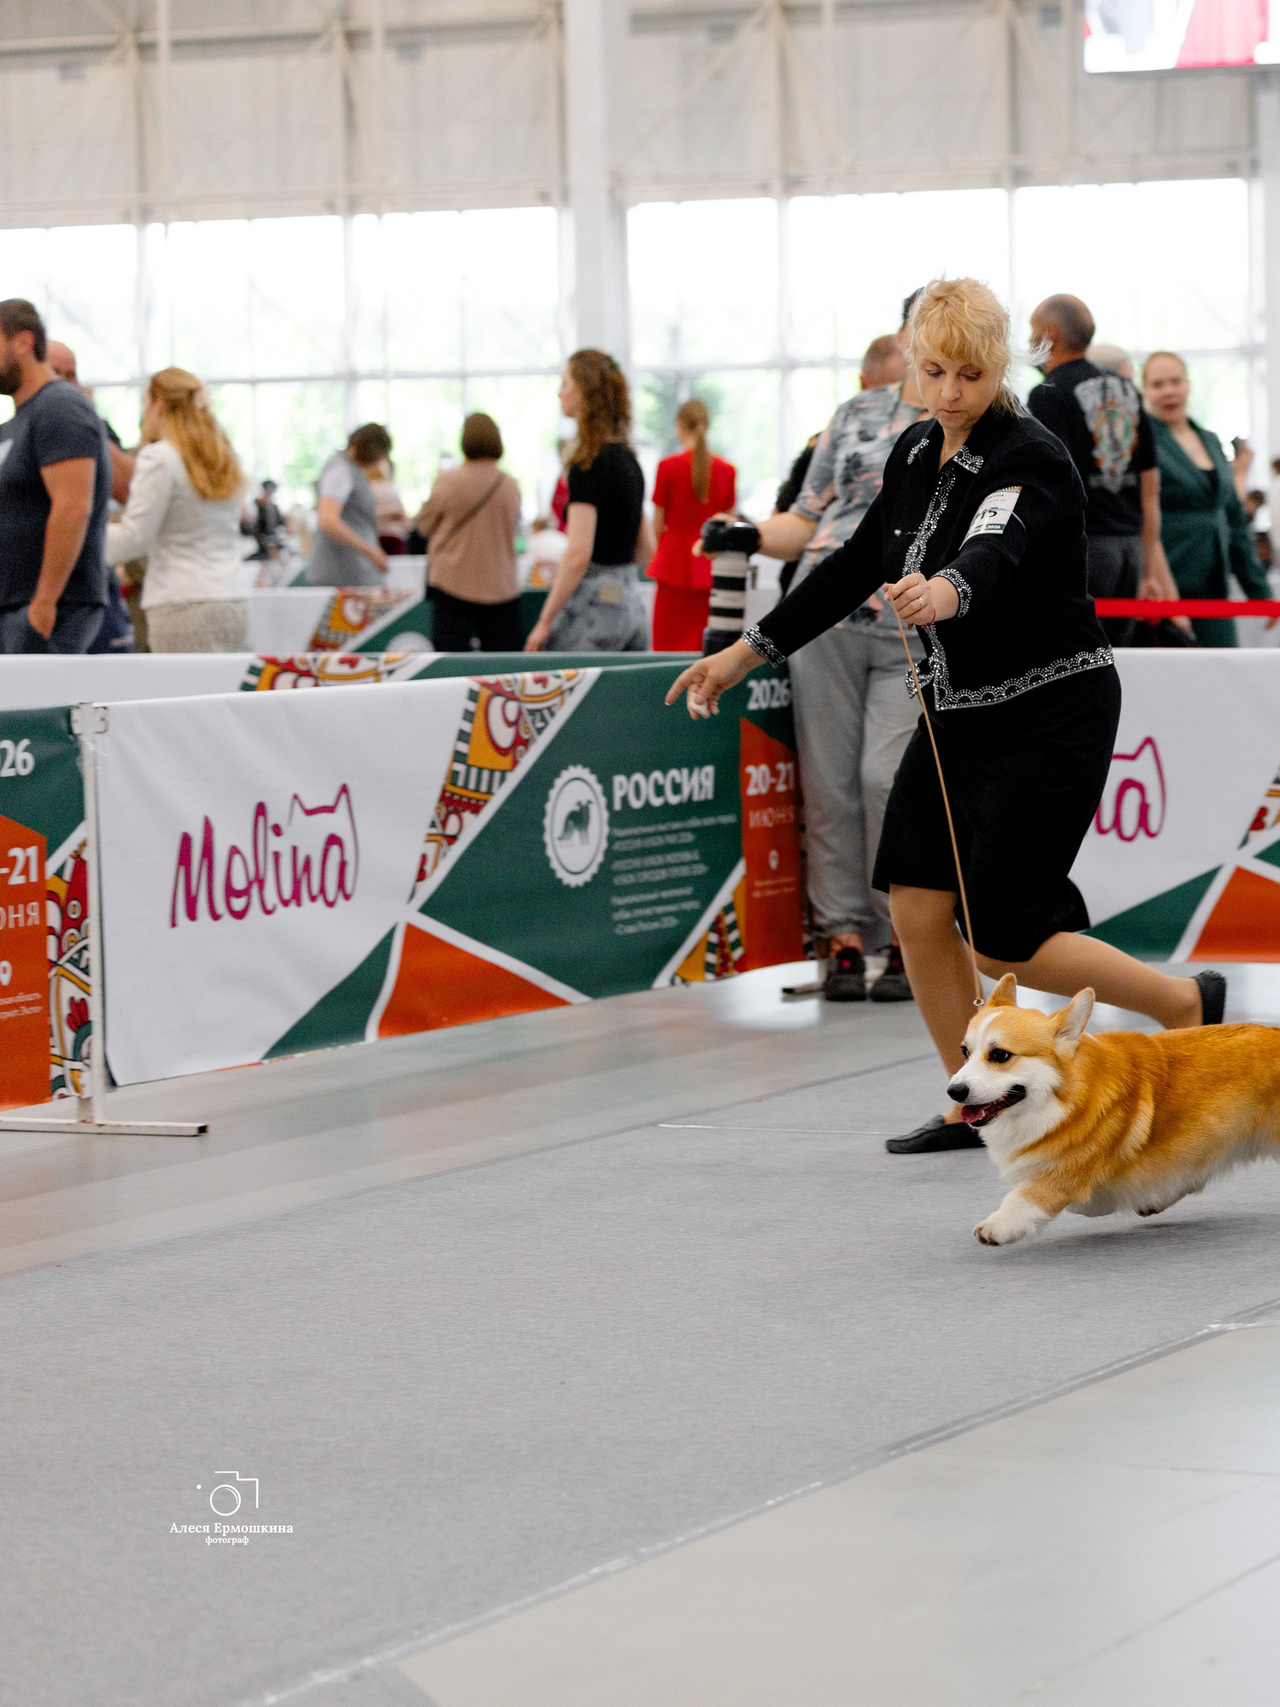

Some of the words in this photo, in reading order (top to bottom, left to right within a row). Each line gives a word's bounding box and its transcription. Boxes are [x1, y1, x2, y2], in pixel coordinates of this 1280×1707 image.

[613, 765, 715, 811] РОССИЯ
[745, 762, 794, 796] 20-21
[170, 783, 359, 928] Molina
